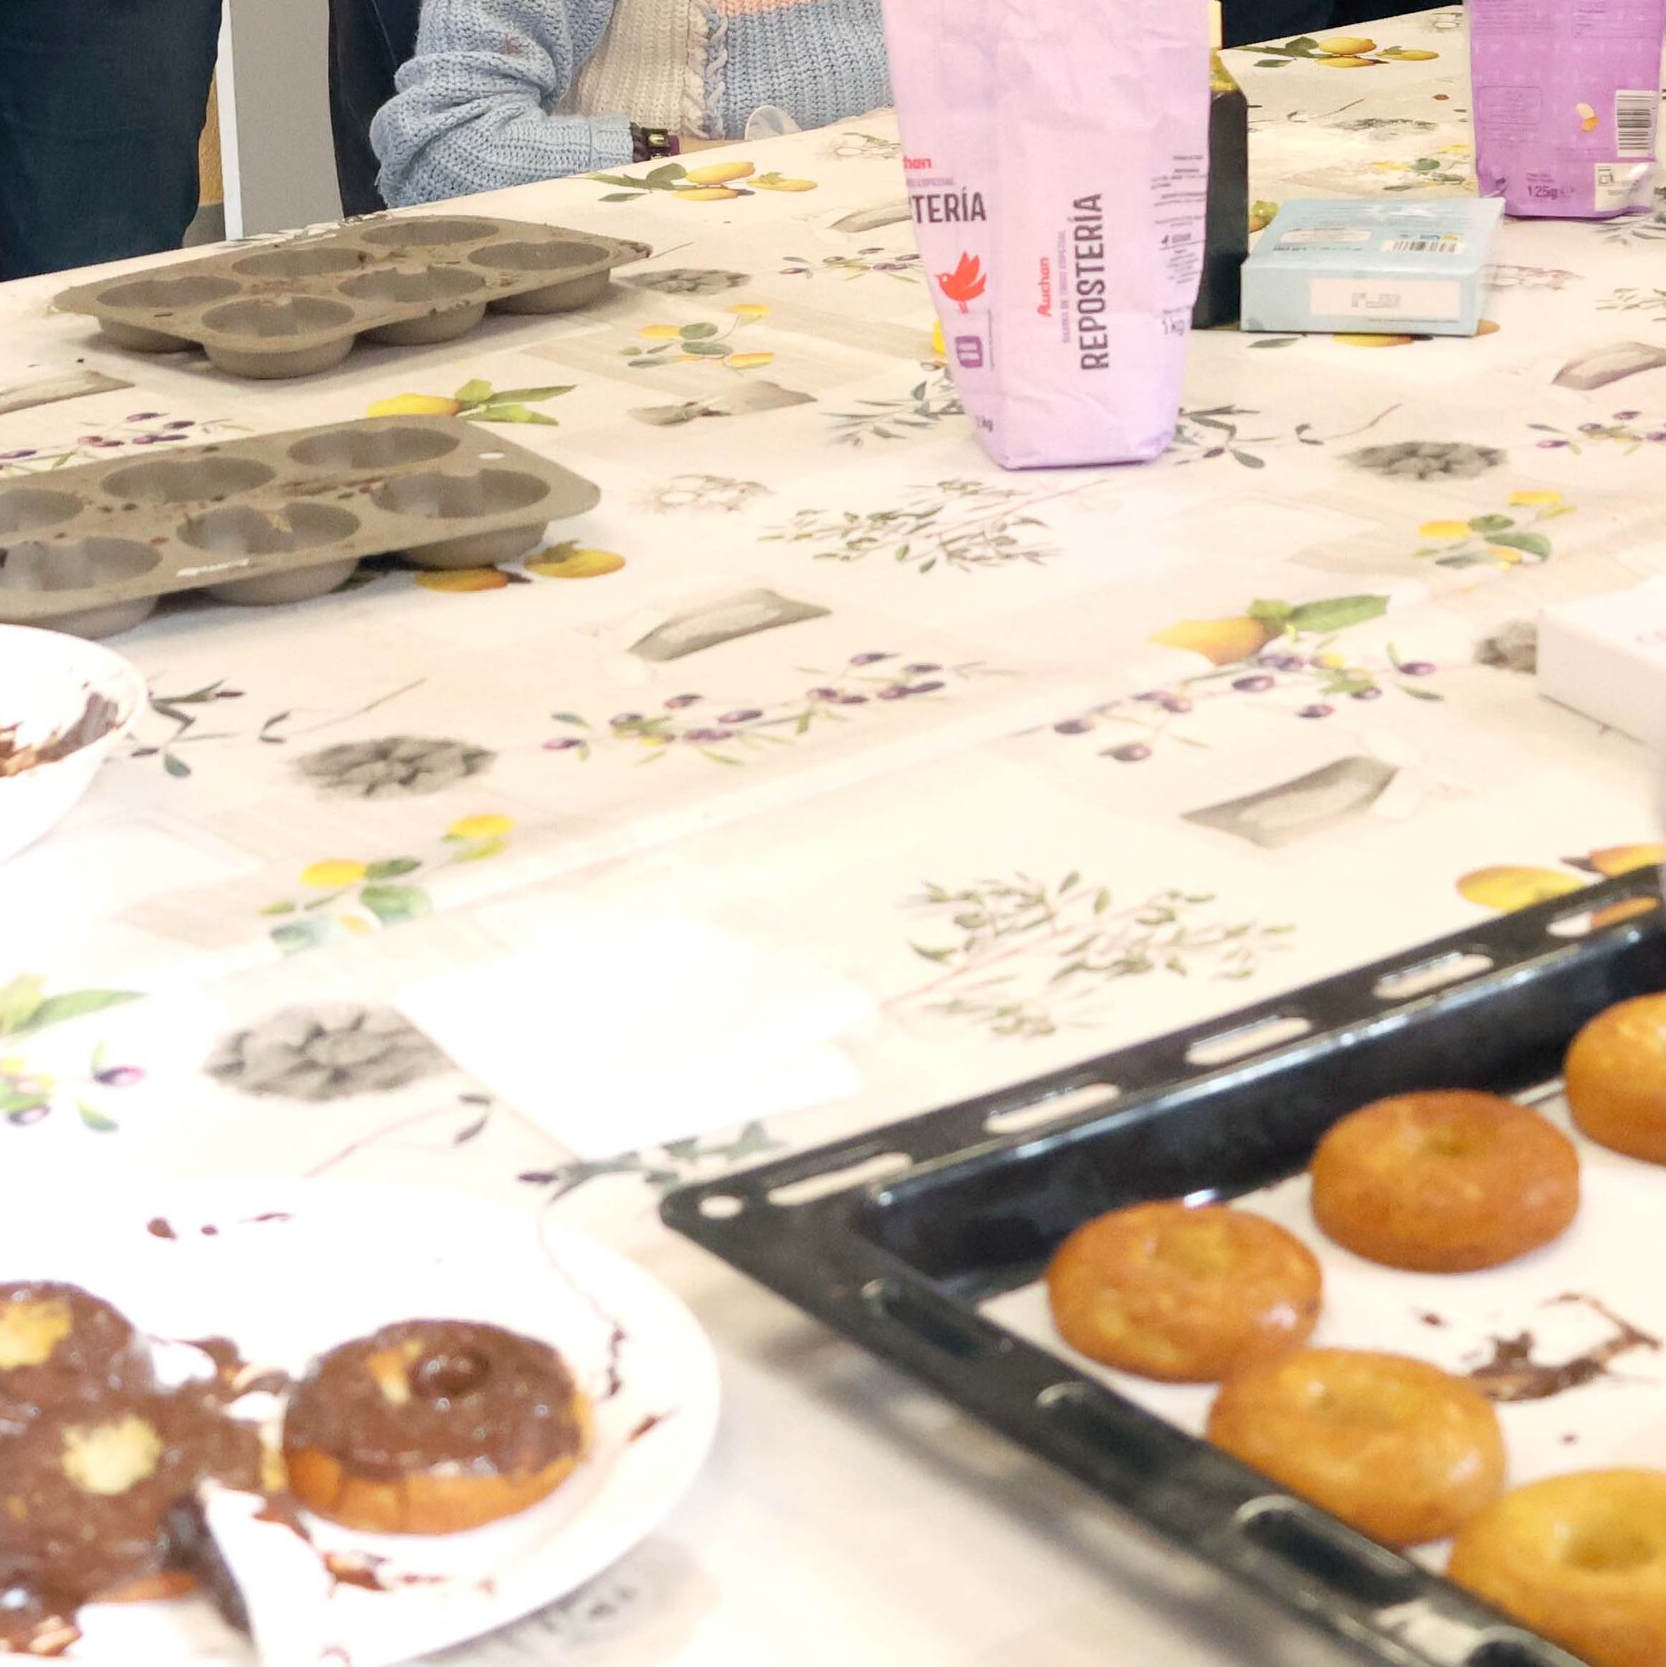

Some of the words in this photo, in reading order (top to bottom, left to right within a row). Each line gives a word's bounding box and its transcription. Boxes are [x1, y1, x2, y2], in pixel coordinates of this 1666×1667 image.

[909, 185, 988, 224] TERÍA
[1036, 256, 1053, 318] Auchan
[1067, 192, 1110, 371] REPOSTERÍA
